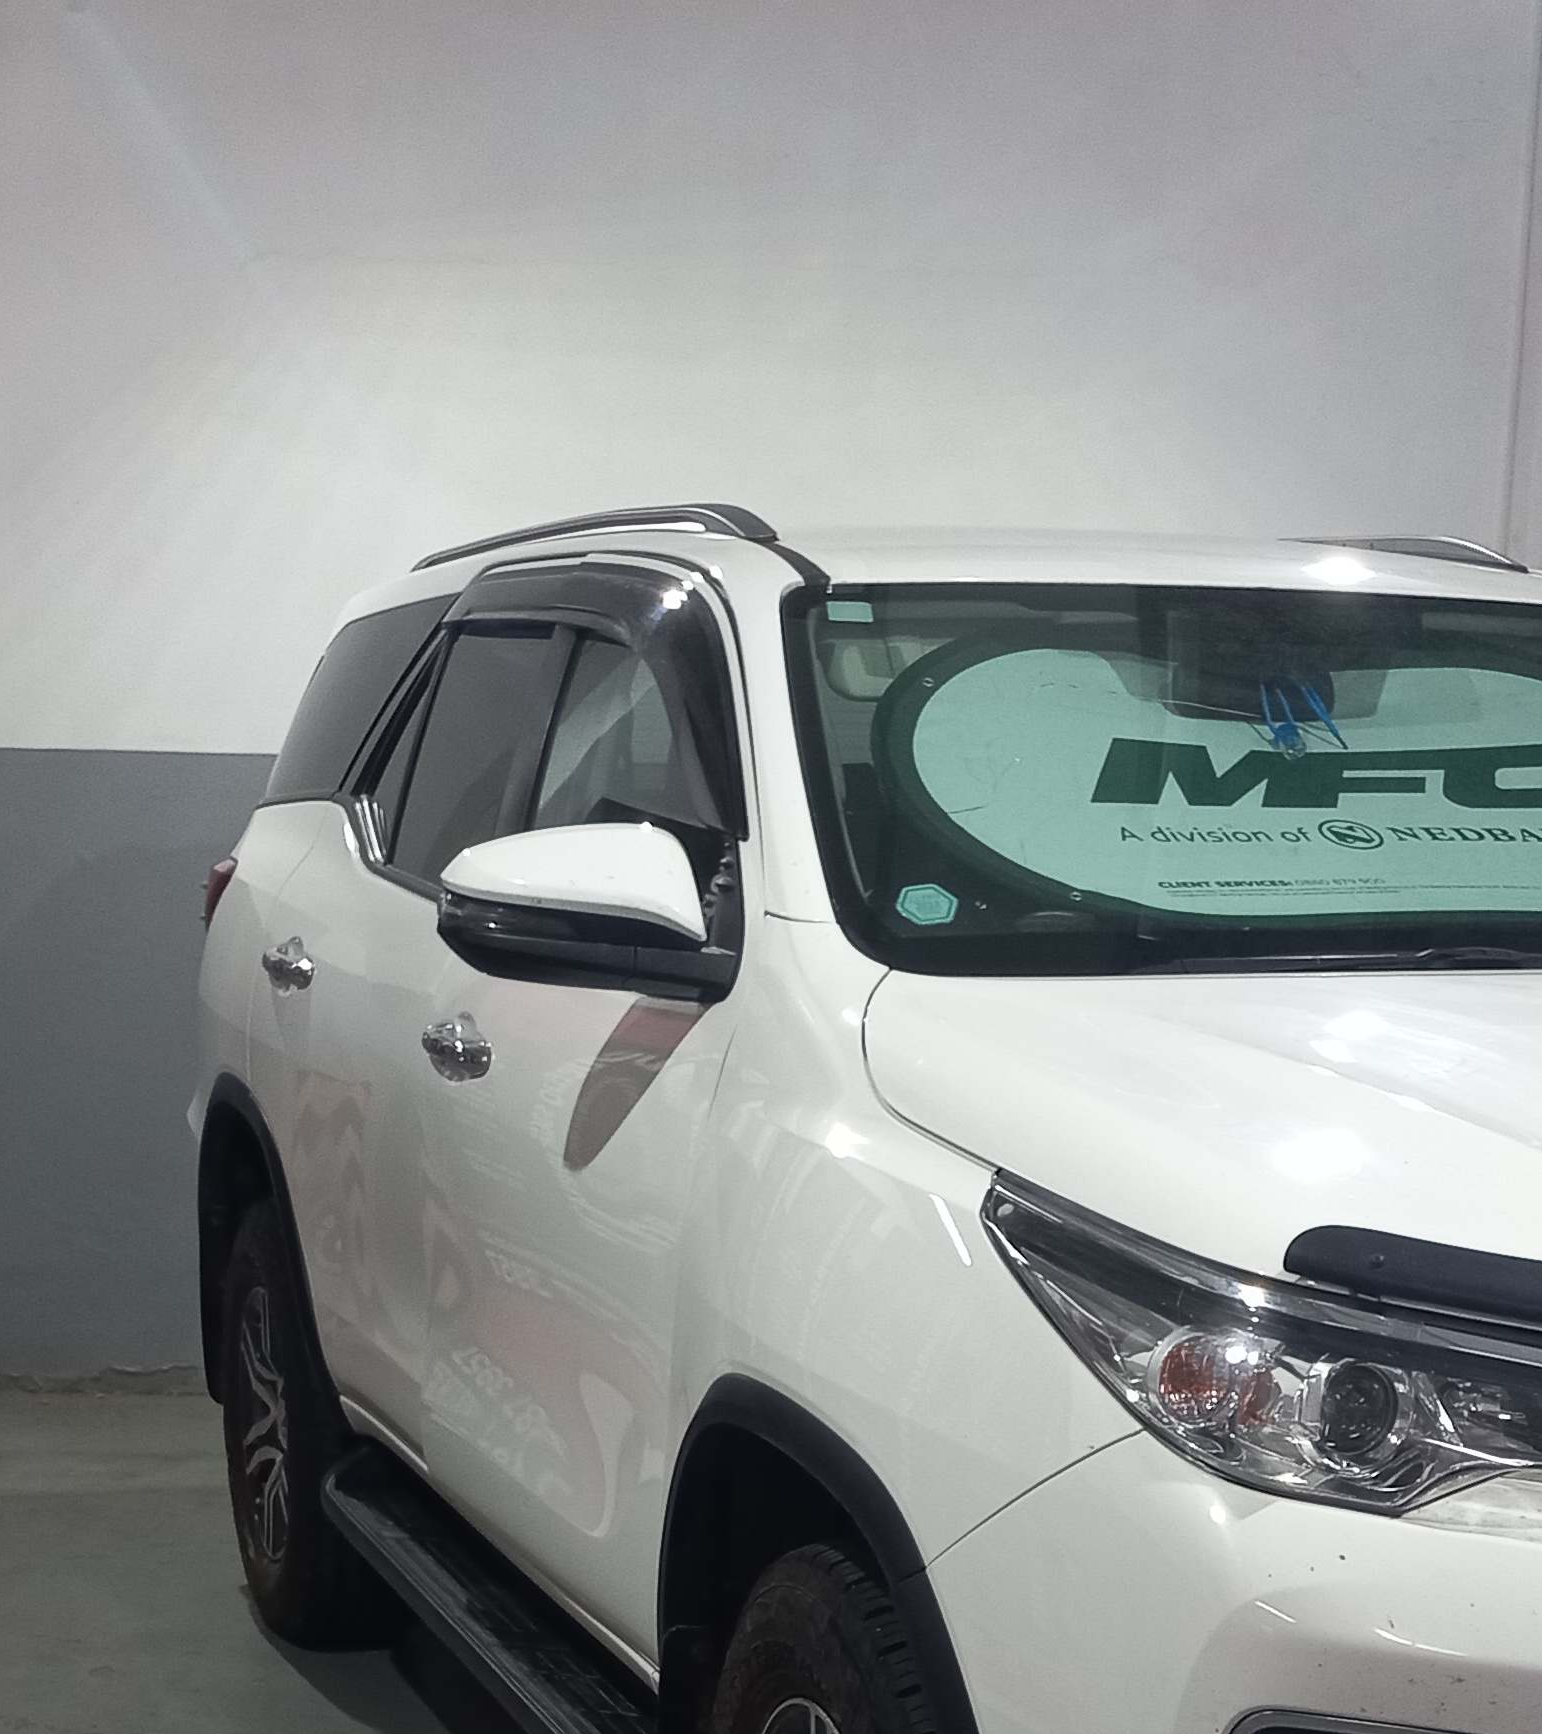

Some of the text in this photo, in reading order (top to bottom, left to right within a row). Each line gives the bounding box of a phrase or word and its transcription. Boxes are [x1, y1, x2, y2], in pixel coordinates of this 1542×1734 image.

[1119, 826, 1144, 842] A
[1150, 824, 1274, 844] division
[1280, 825, 1311, 843] of
